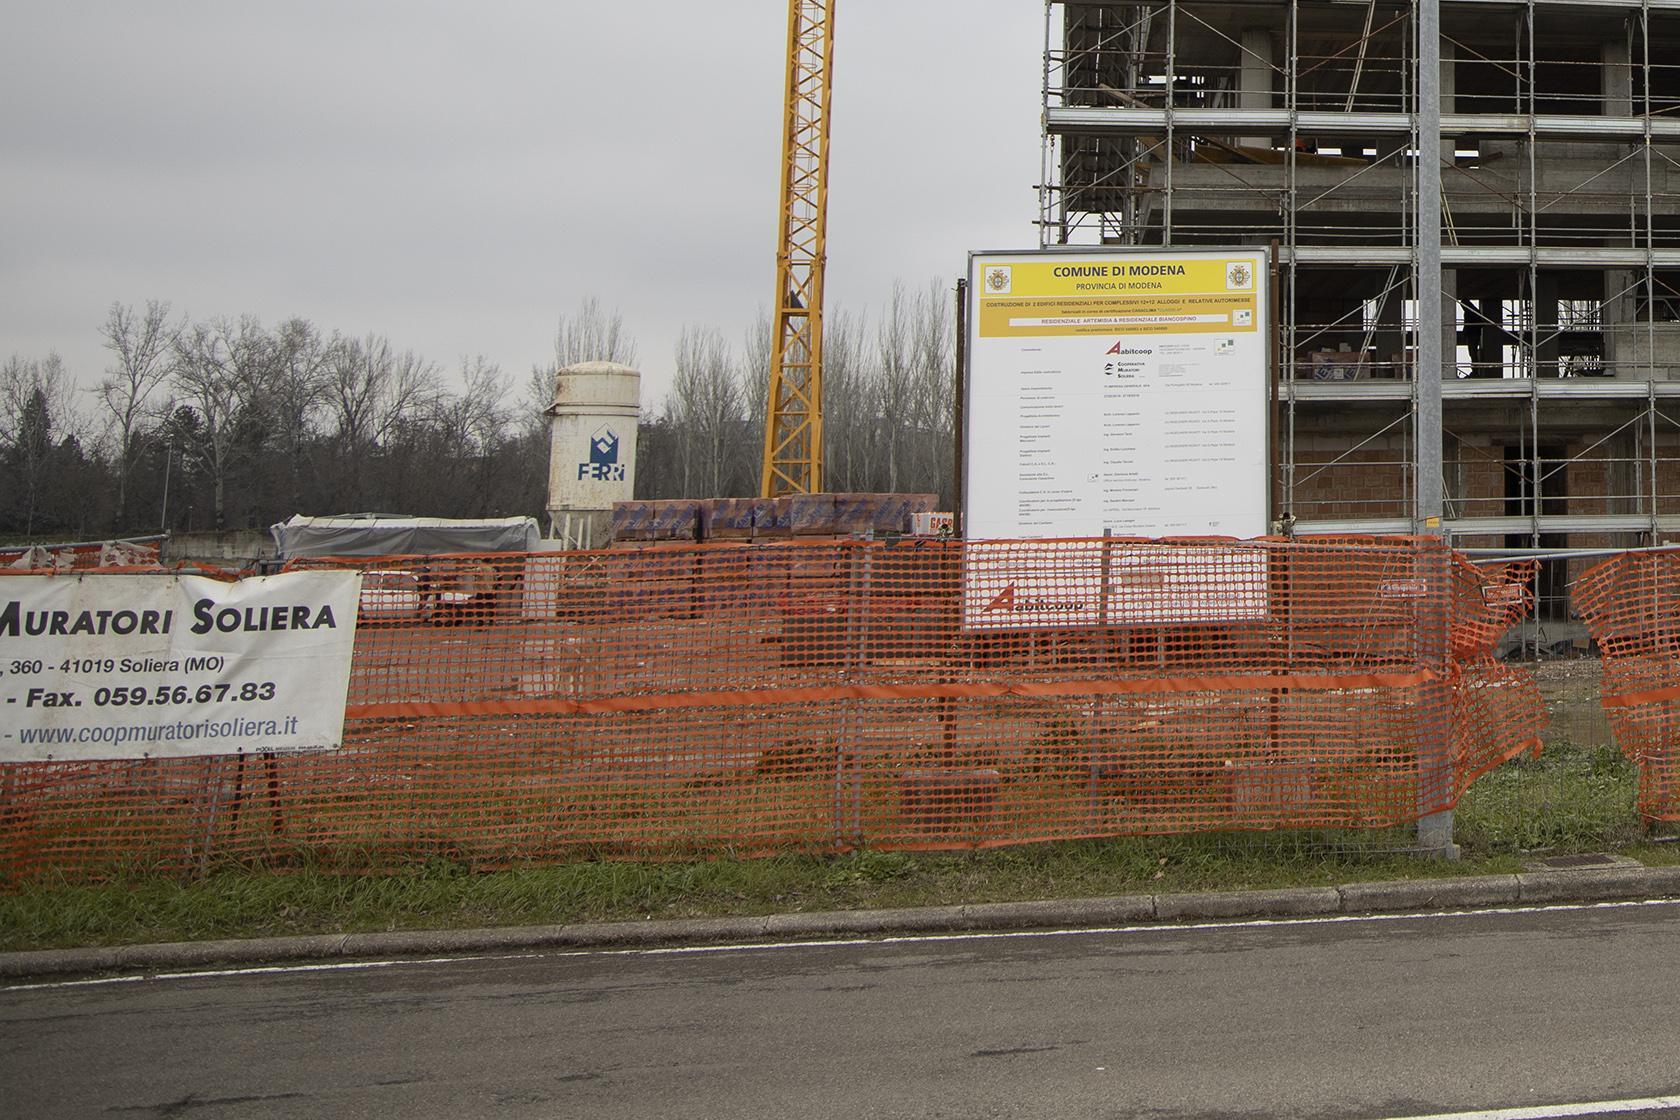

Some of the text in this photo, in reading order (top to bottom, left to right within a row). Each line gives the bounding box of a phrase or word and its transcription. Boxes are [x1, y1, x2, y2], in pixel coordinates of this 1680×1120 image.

[1053, 265, 1185, 277] COMUNE DI MODENA
[190, 598, 336, 635] SOLIERA
[10, 660, 42, 674] 360
[60, 659, 115, 674] 41019
[119, 658, 179, 672] Soliera
[184, 656, 225, 674] (MO)
[26, 688, 82, 707] Fax.
[94, 682, 276, 707] 059.56.67.83
[20, 716, 298, 746] www.coopmuratorisoliera.it
